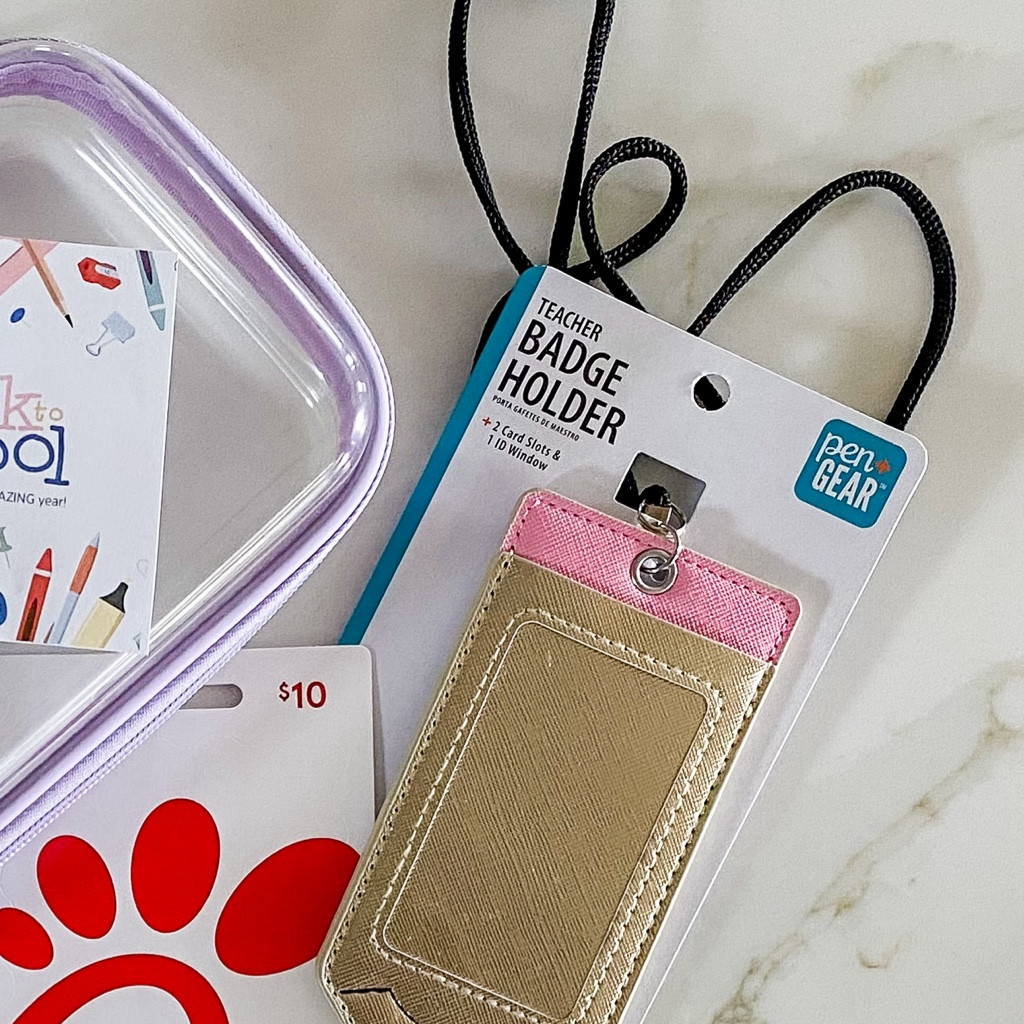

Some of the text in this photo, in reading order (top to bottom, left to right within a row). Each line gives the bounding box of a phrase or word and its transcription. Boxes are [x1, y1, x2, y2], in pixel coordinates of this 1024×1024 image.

[536, 297, 603, 342] TEACHER
[517, 318, 629, 396] BADGE
[35, 401, 64, 422] to
[492, 395, 580, 442] PORTA GAFETES DE MAESTRO
[497, 359, 626, 445] HOLDER
[487, 434, 549, 471] 1 ID Window
[492, 421, 561, 461] 2 Card Slots &
[39, 495, 67, 507] year!
[811, 458, 878, 513] GEAR
[279, 681, 327, 709] $10
